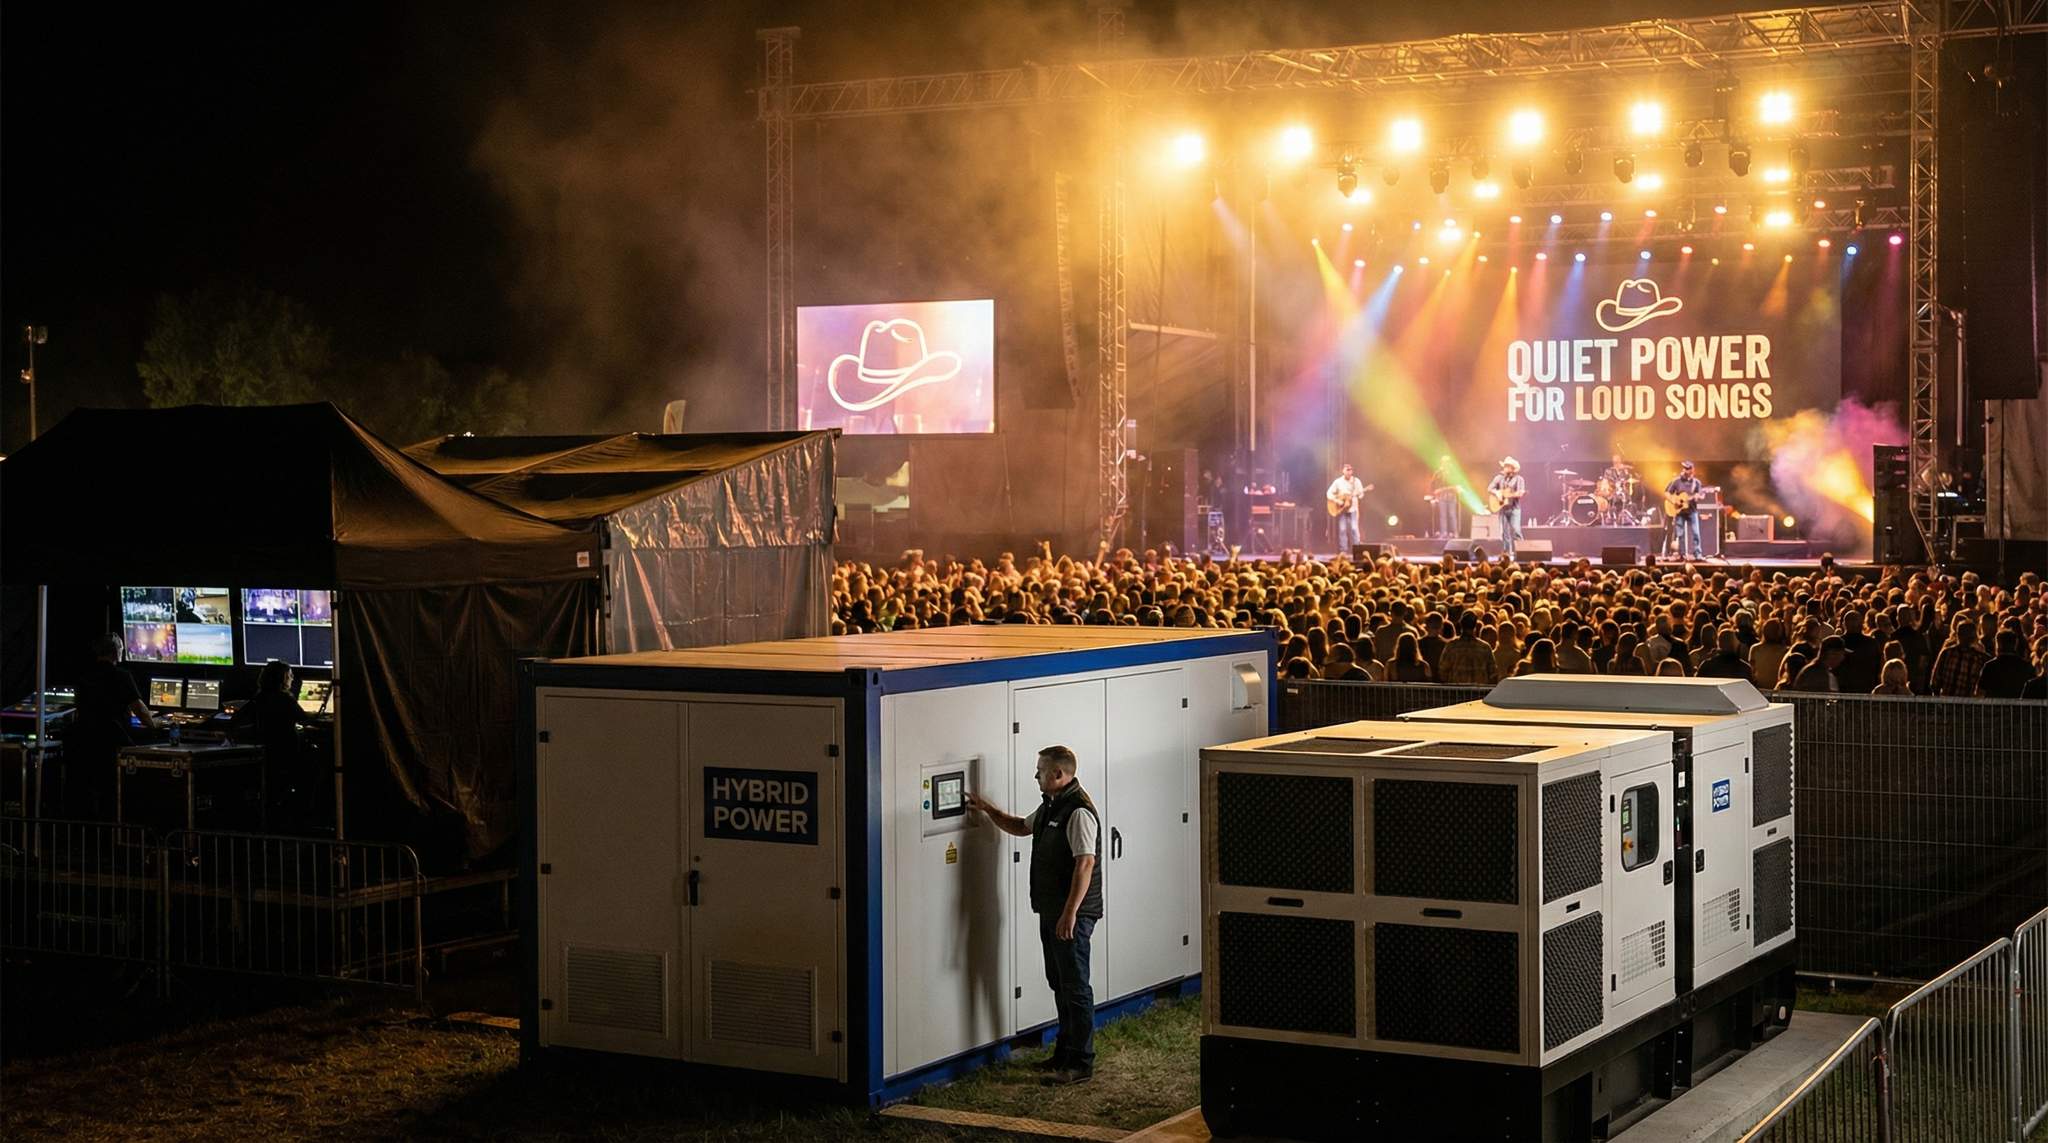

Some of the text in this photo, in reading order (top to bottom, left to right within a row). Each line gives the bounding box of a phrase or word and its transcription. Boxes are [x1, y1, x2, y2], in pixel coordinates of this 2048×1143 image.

[1507, 334, 1771, 393] QUIET POWER
[1508, 382, 1773, 422] FOR LOUD SONGS
[712, 777, 809, 805] HYBRID
[713, 806, 808, 834] POWER
